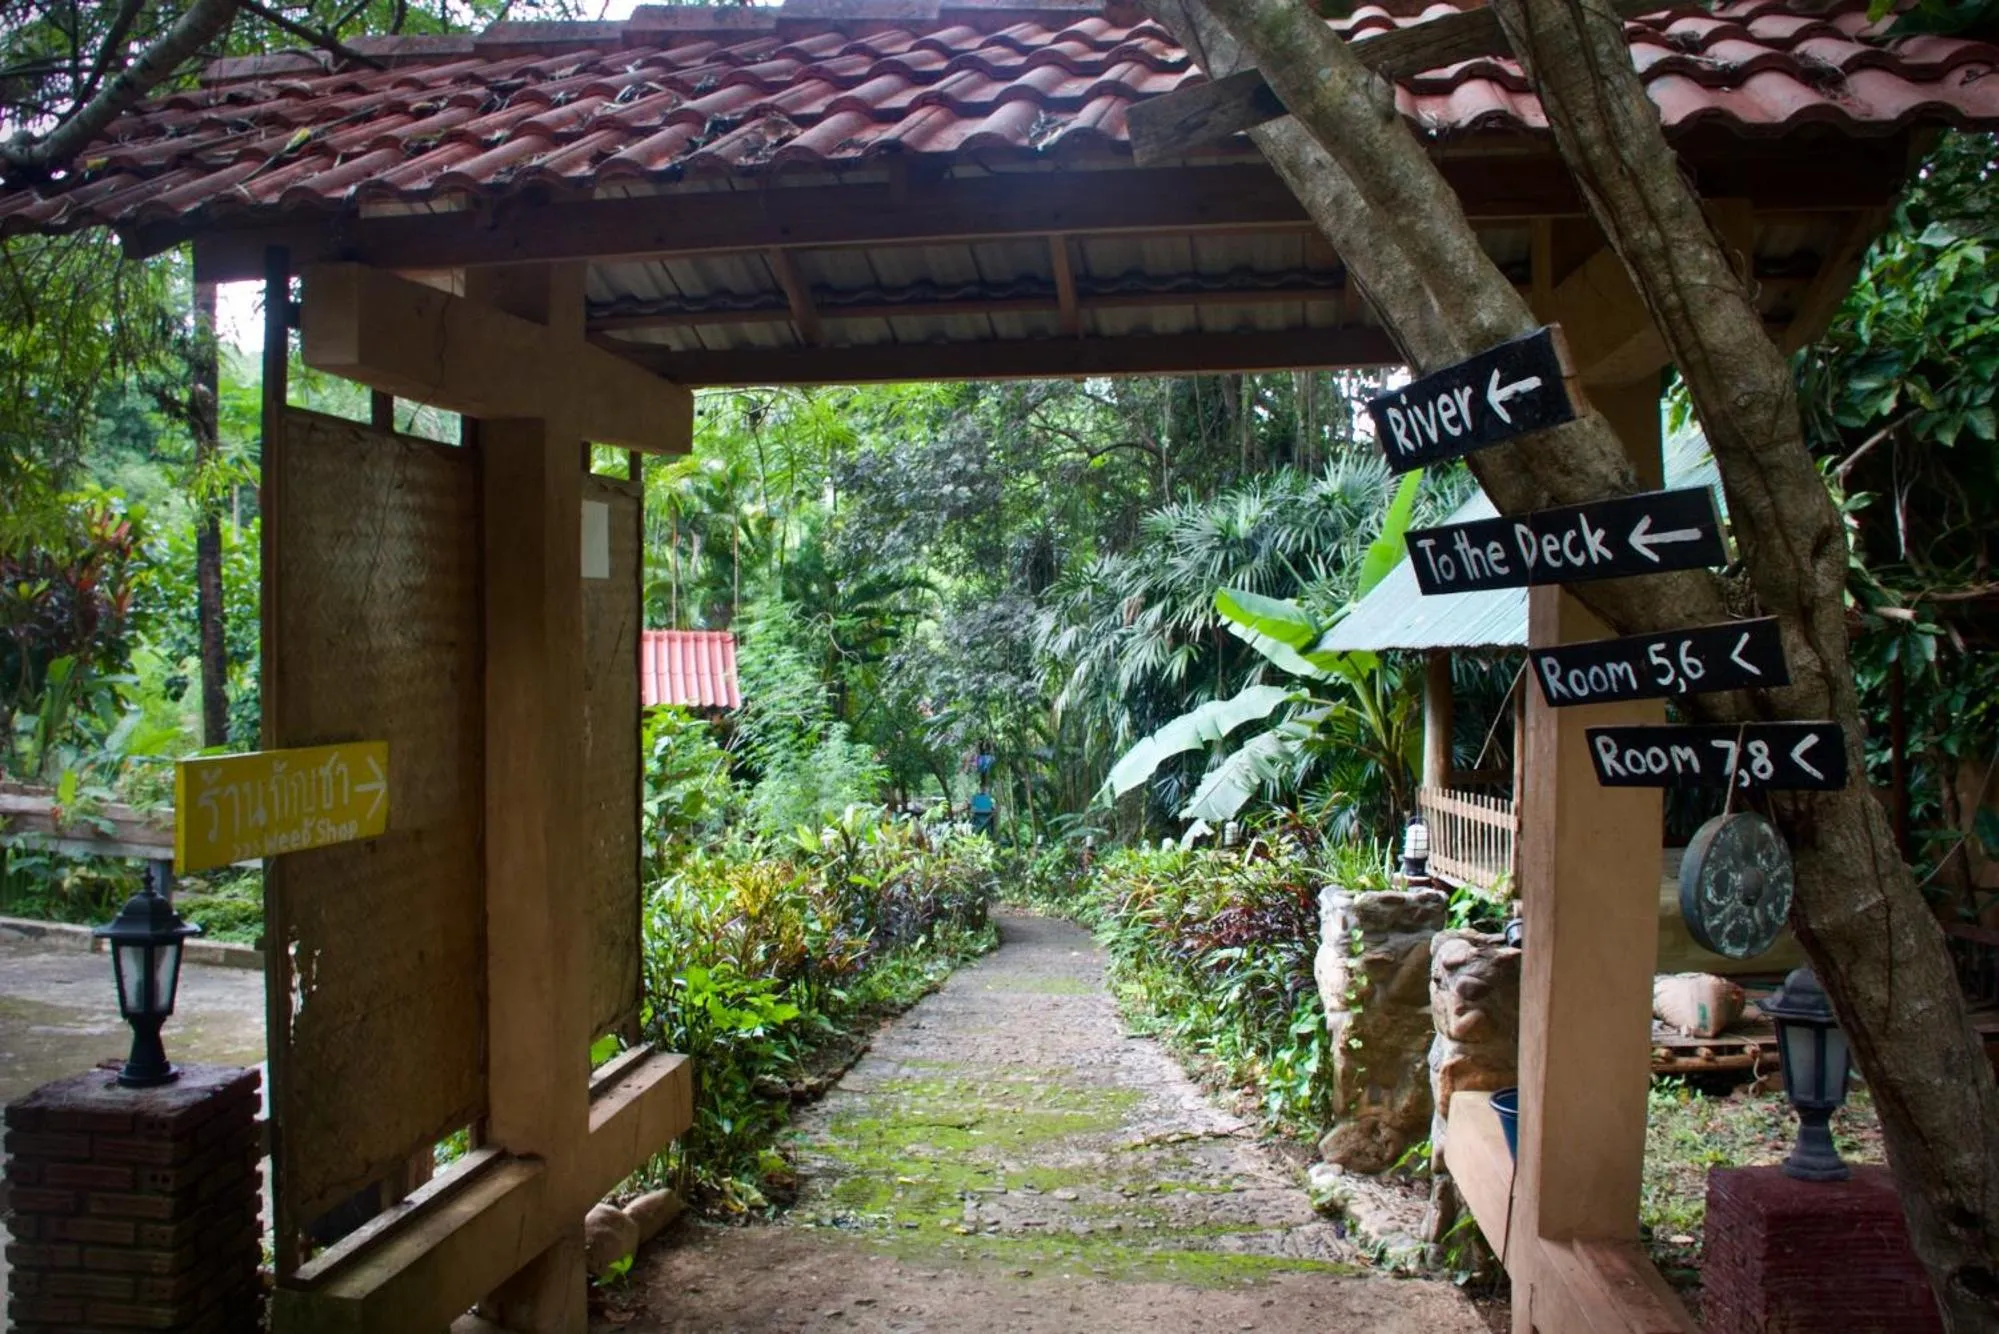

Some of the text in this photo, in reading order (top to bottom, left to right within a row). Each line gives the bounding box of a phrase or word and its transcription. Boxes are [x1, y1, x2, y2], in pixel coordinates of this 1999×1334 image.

[1386, 382, 1473, 456] River
[1416, 513, 1613, 585] To the Deck
[1540, 639, 1706, 699] Room 5,6
[1594, 735, 1775, 787] Room 7,8
[316, 817, 359, 845] Shop
